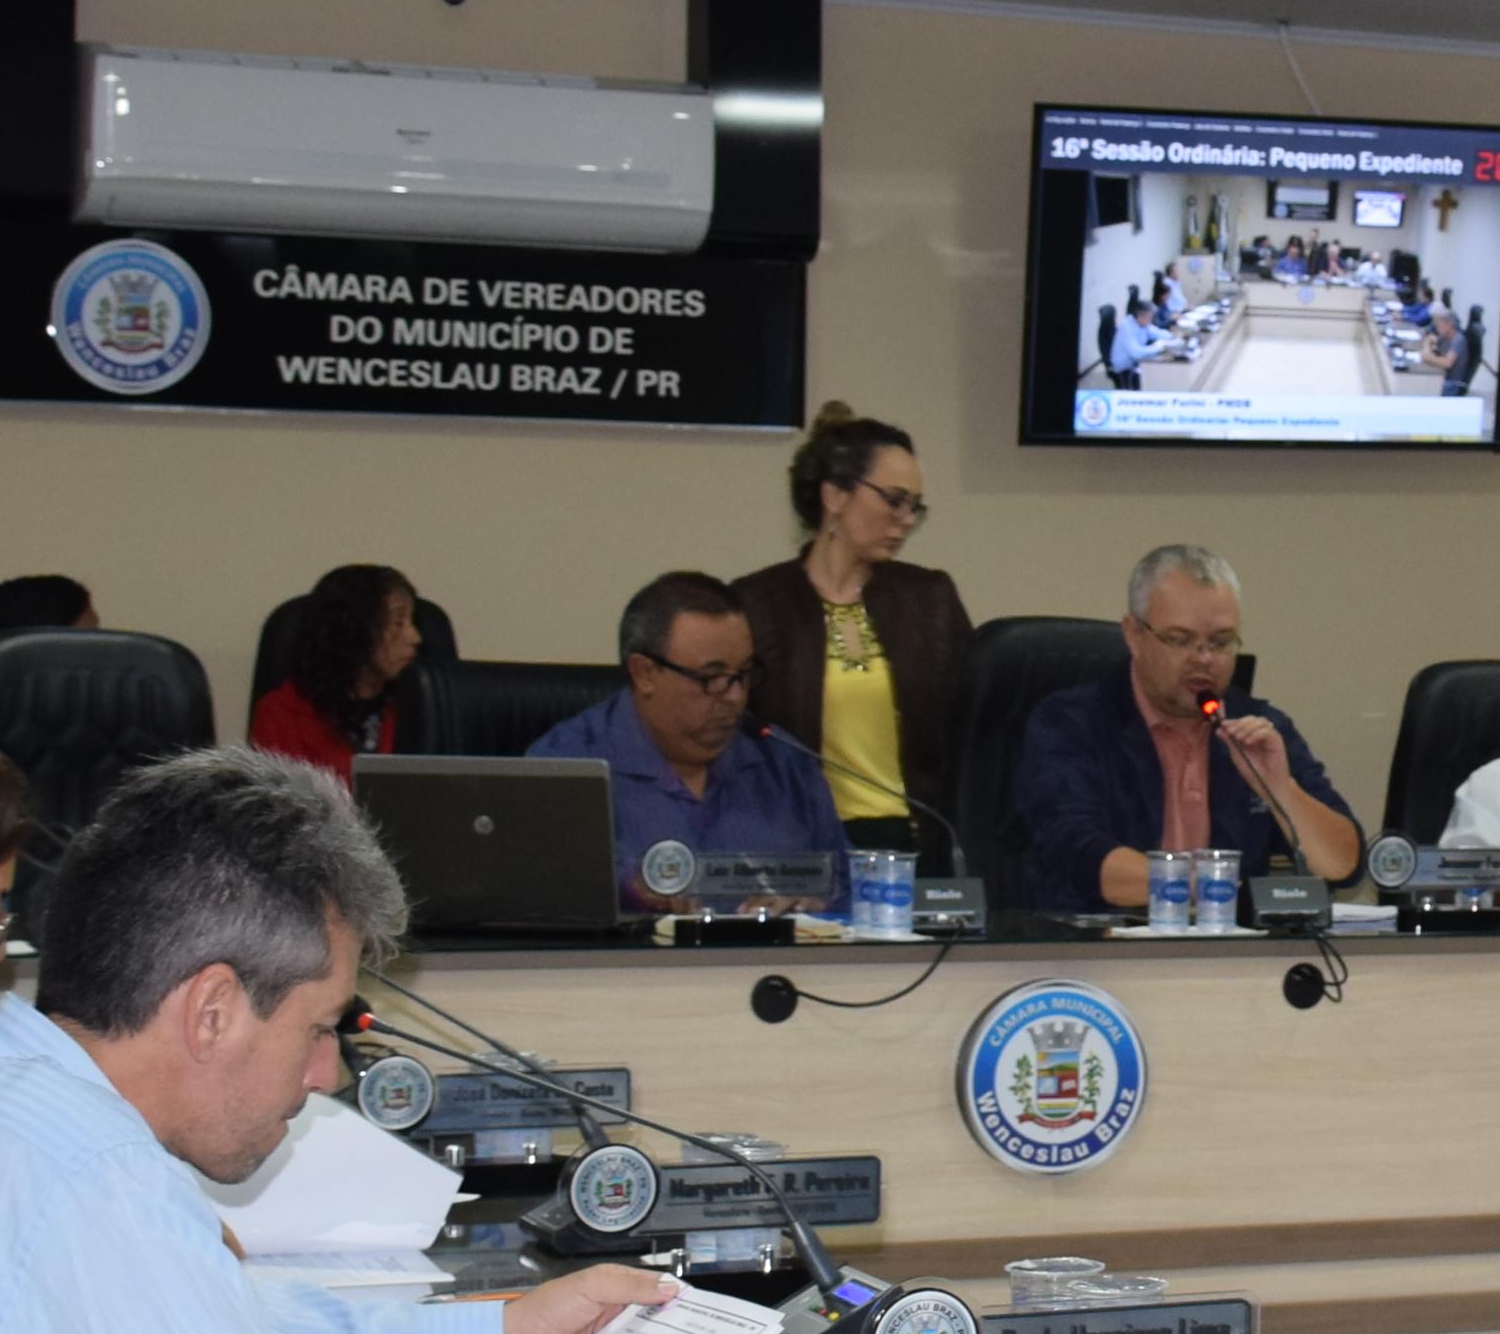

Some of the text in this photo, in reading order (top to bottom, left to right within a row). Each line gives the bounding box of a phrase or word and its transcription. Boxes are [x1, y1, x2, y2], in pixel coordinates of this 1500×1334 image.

[1091, 138, 1165, 163] Sessão
[1168, 141, 1266, 167] Ordinária:
[1269, 146, 1356, 172] Pequeno
[1359, 151, 1463, 175] Expediente
[253, 263, 706, 318] CÂMARA DE VEREADORES
[329, 315, 635, 356] DO MUNICÍPIO DE
[276, 355, 500, 392] WENCESLAU
[510, 364, 602, 395] BRAZ
[635, 369, 681, 398] PR
[977, 1087, 1136, 1164] Wenceslau Braz
[932, 1303, 958, 1323] BRAZ
